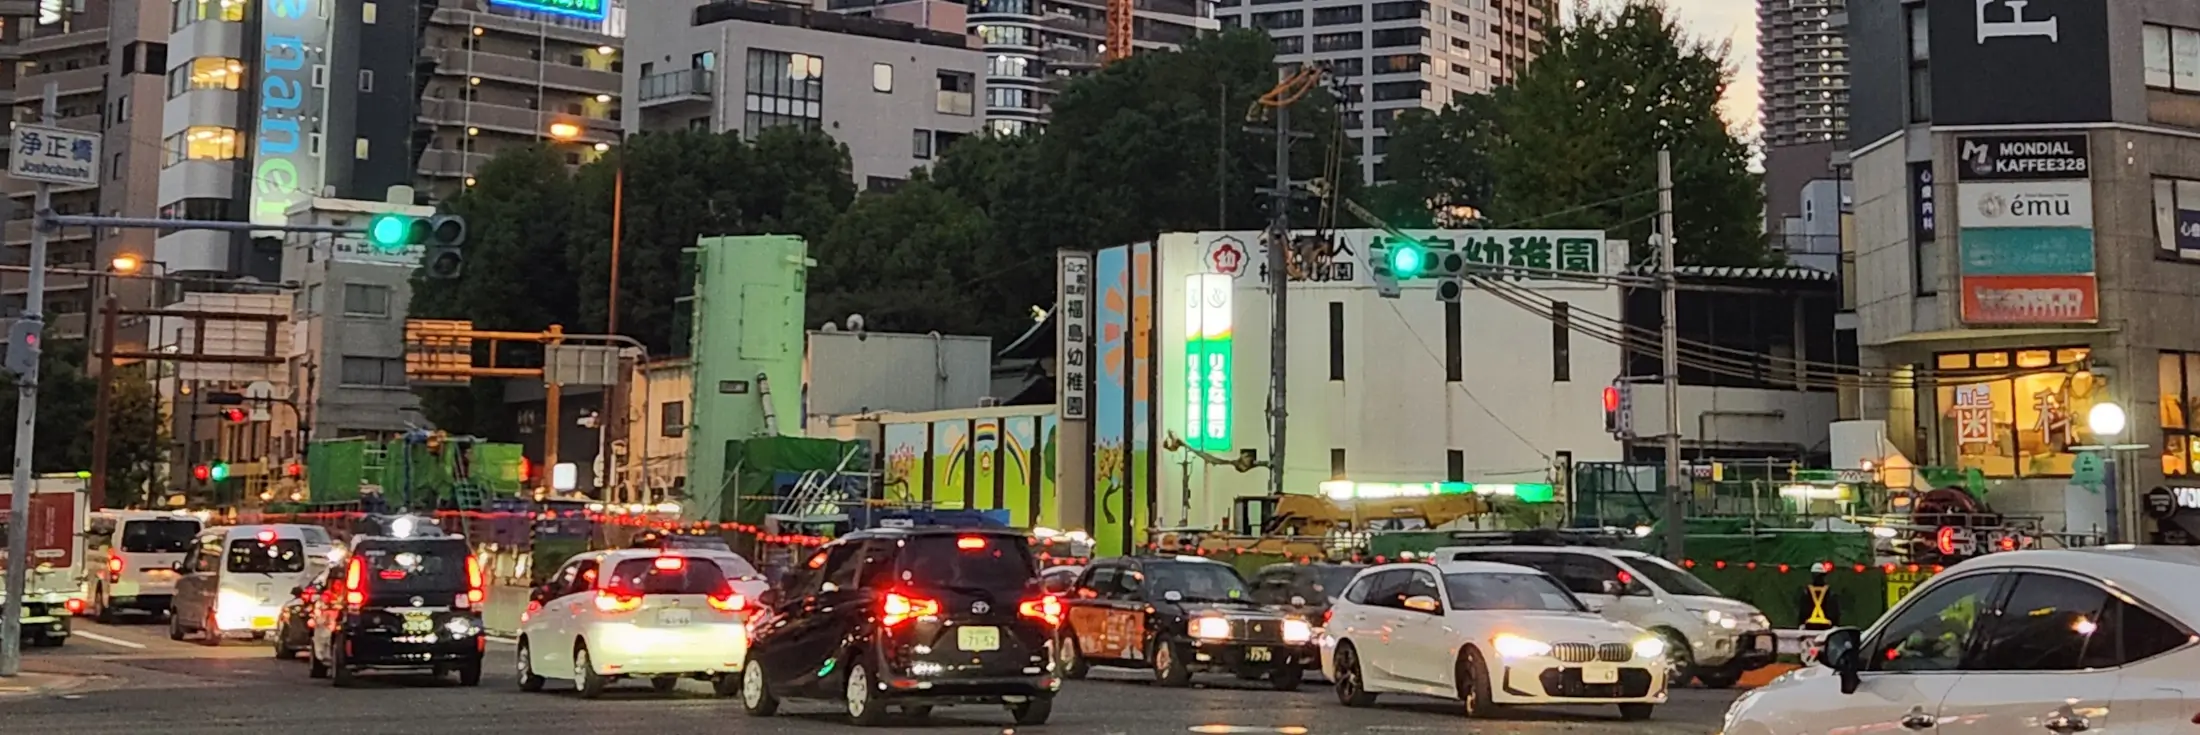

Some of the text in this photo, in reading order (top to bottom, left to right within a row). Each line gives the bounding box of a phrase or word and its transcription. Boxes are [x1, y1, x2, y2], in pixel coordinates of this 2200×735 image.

[19, 131, 93, 163] 浄正橋
[1999, 141, 2073, 157] MONDIAL
[20, 159, 90, 178] Joshobashi
[1995, 157, 2087, 173] KAFFEE328
[2010, 193, 2071, 216] ému
[1369, 235, 1599, 281] 幼稚園
[1066, 300, 1084, 416] 福島幼稚園
[1953, 376, 2073, 446] 歯科
